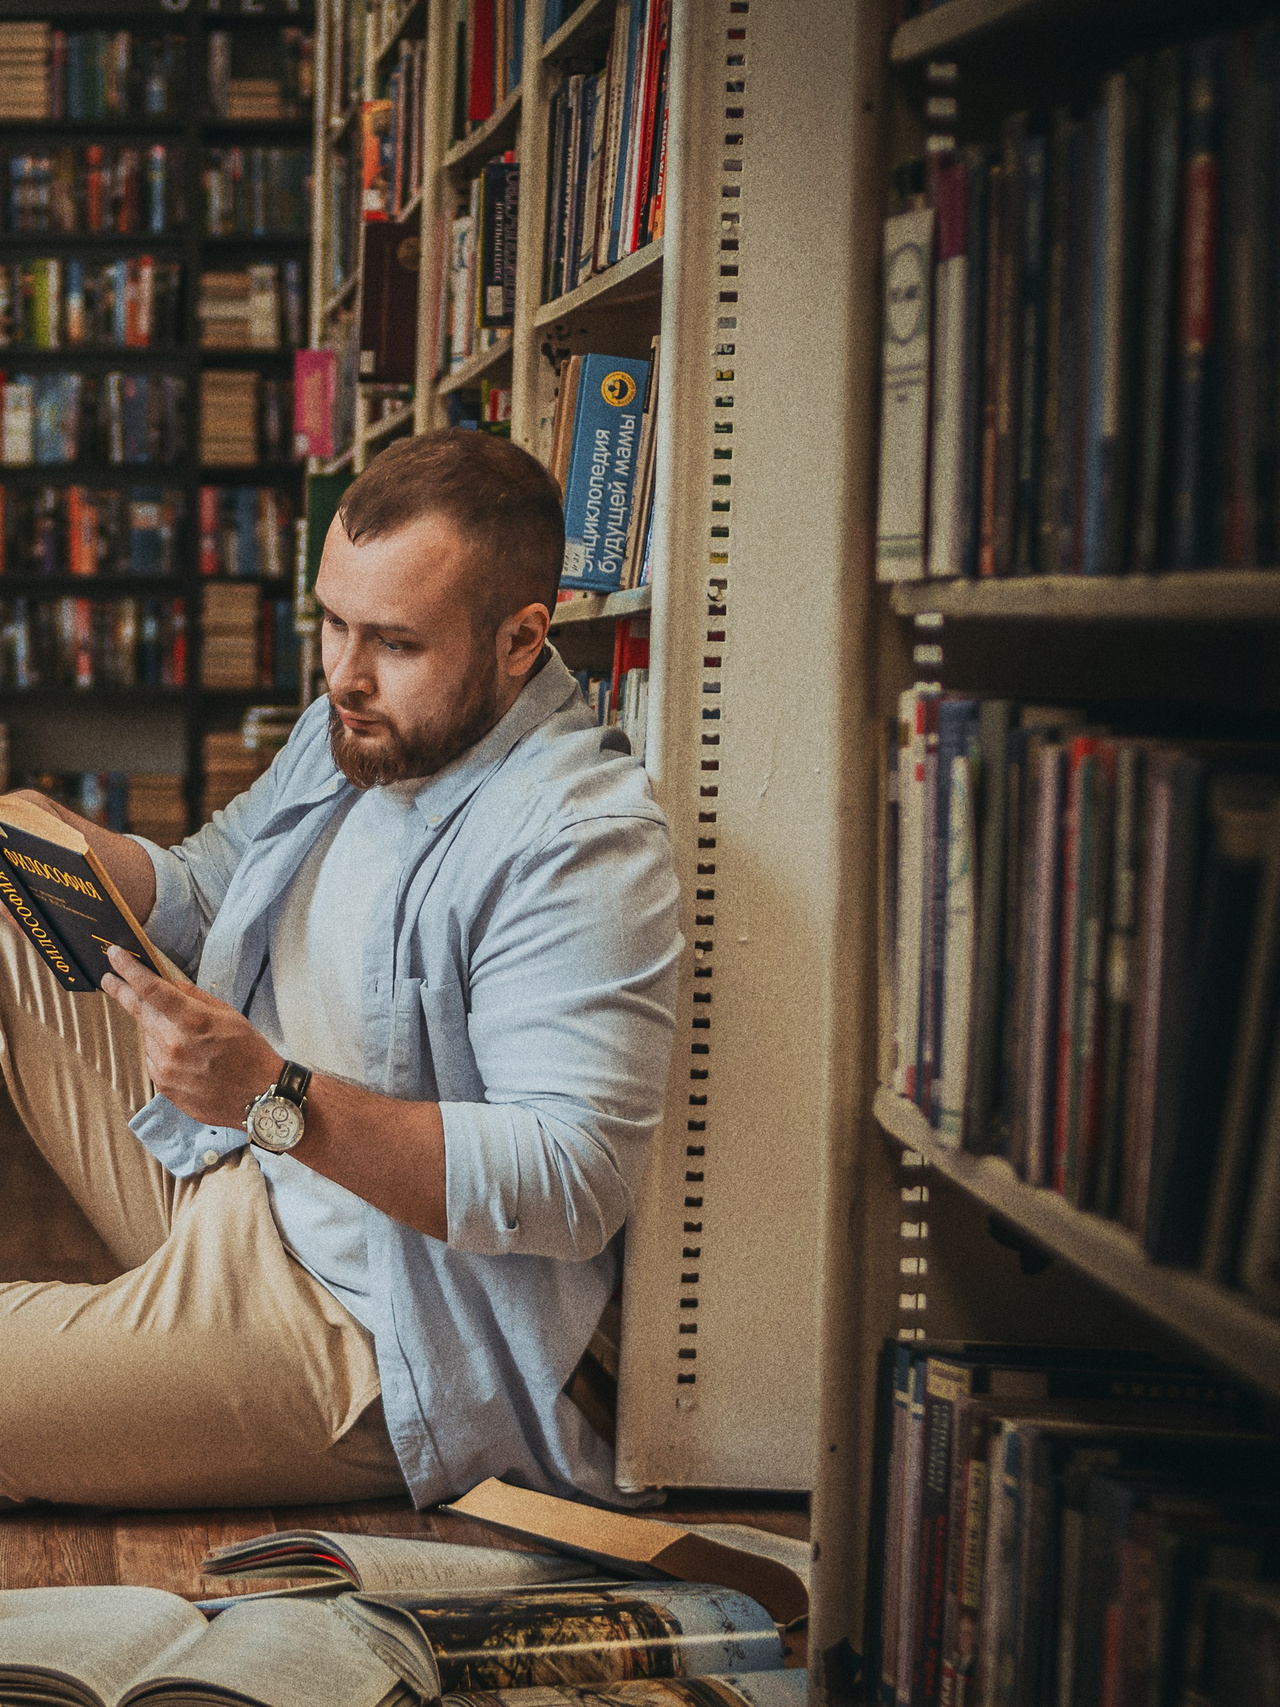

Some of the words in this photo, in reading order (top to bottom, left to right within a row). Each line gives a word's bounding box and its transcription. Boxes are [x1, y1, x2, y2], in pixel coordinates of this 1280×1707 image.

[598, 482, 628, 574] будущей
[614, 413, 637, 477] мамы
[3, 847, 103, 901] ФИЛОСОФИЯ
